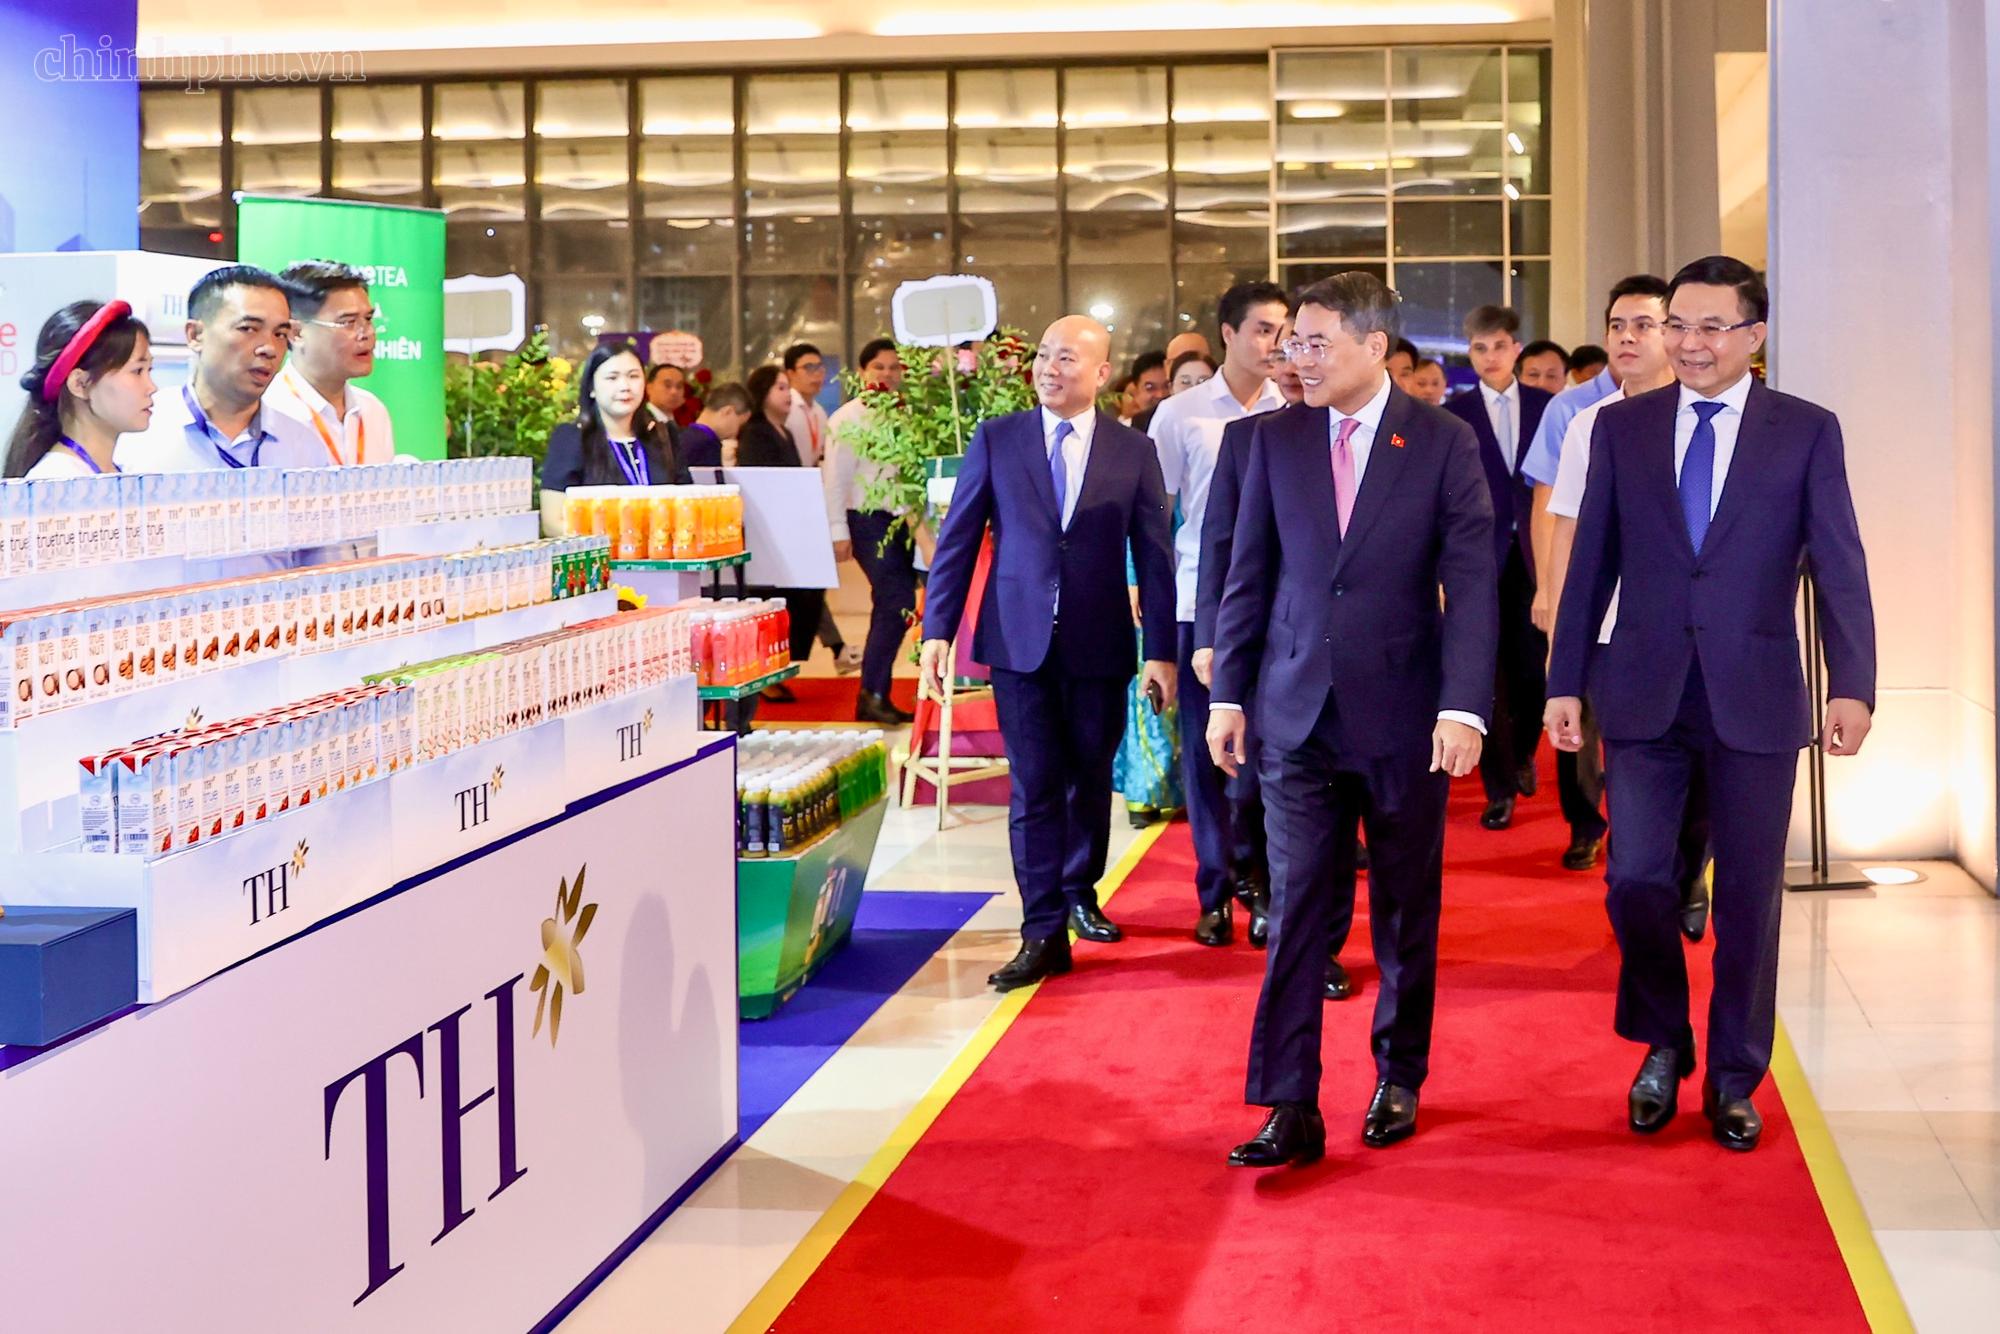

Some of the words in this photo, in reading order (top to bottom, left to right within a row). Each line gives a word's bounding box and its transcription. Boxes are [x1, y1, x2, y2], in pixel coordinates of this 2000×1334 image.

[99, 515, 110, 526] TH
[168, 509, 178, 519] TH
[37, 521, 48, 532] TH
[55, 519, 66, 530] TH
[79, 517, 90, 528] TH
[10, 524, 22, 535] TH
[78, 529, 98, 543] true
[99, 528, 119, 541] true
[147, 523, 164, 536] true
[36, 534, 55, 548] true
[55, 531, 74, 546] true
[89, 644, 104, 656] NUT
[114, 639, 128, 651] NUT
[62, 648, 78, 661] NUT
[616, 721, 643, 762] TH
[225, 783, 240, 796] true
[203, 790, 218, 803] true
[178, 797, 194, 811] true
[454, 782, 490, 832] TH
[243, 863, 290, 925] TH
[324, 972, 527, 1307] TH
